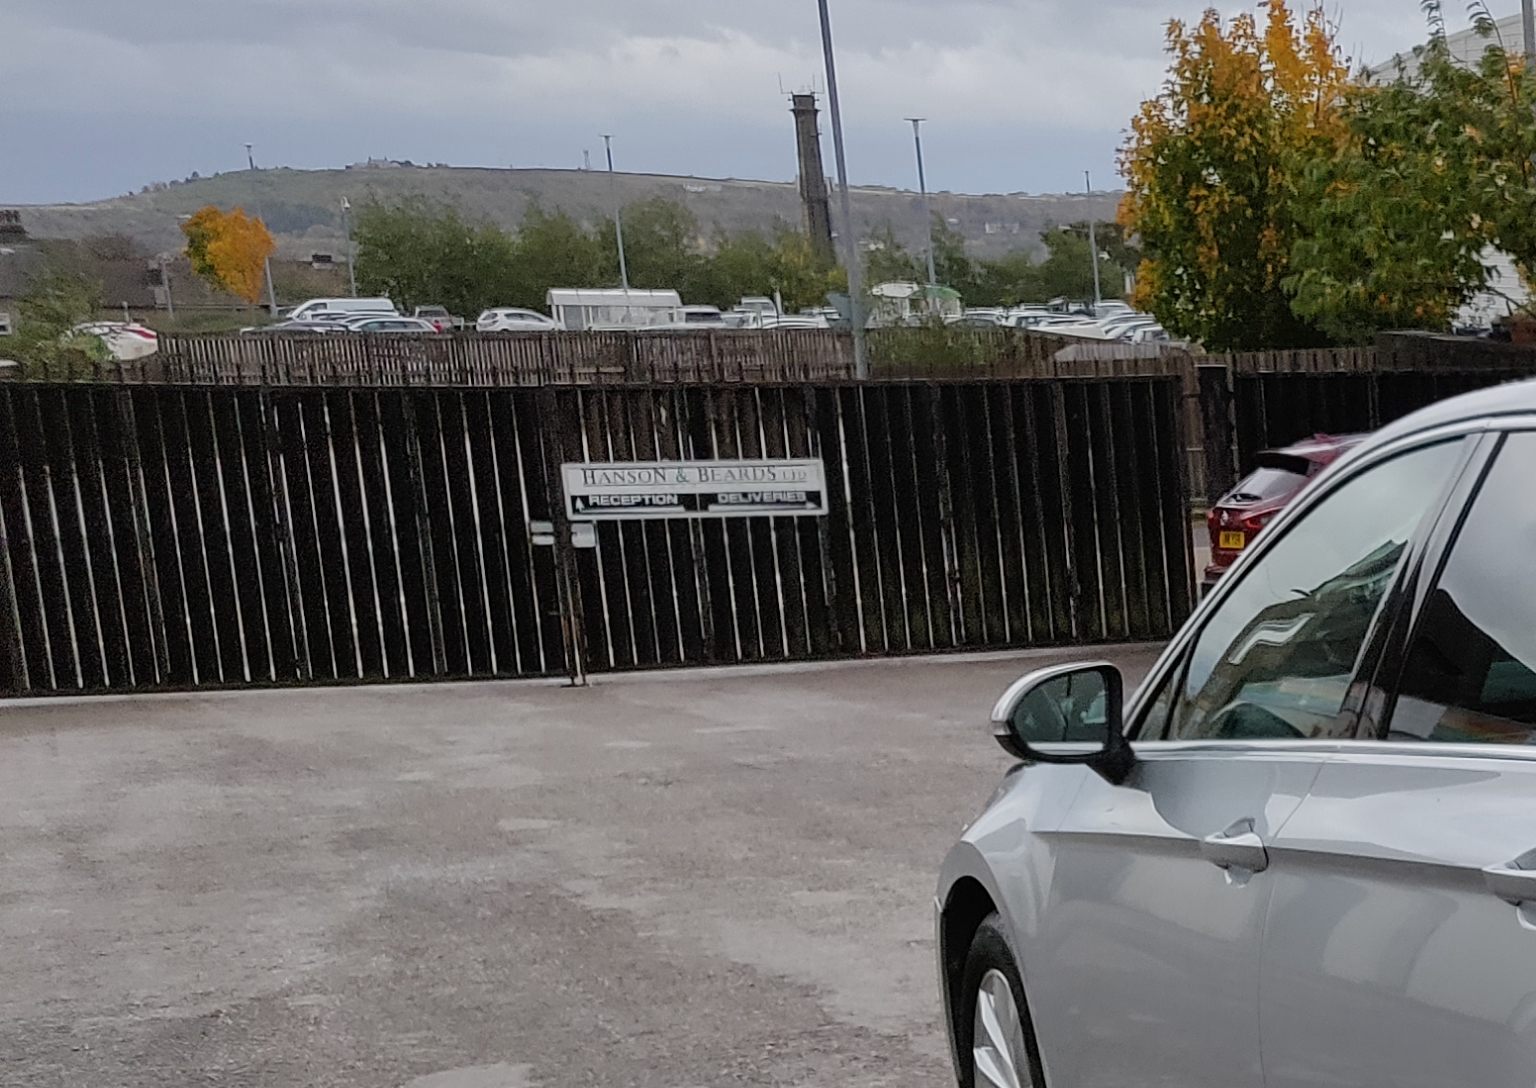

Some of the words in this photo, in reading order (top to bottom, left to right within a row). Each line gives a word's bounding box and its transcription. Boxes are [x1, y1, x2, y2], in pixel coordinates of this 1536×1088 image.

[582, 467, 667, 485] HANSON
[676, 466, 690, 483] &
[697, 465, 776, 483] BEARDS
[588, 493, 679, 506] RECEPTION
[717, 491, 807, 504] DELIVERIES
